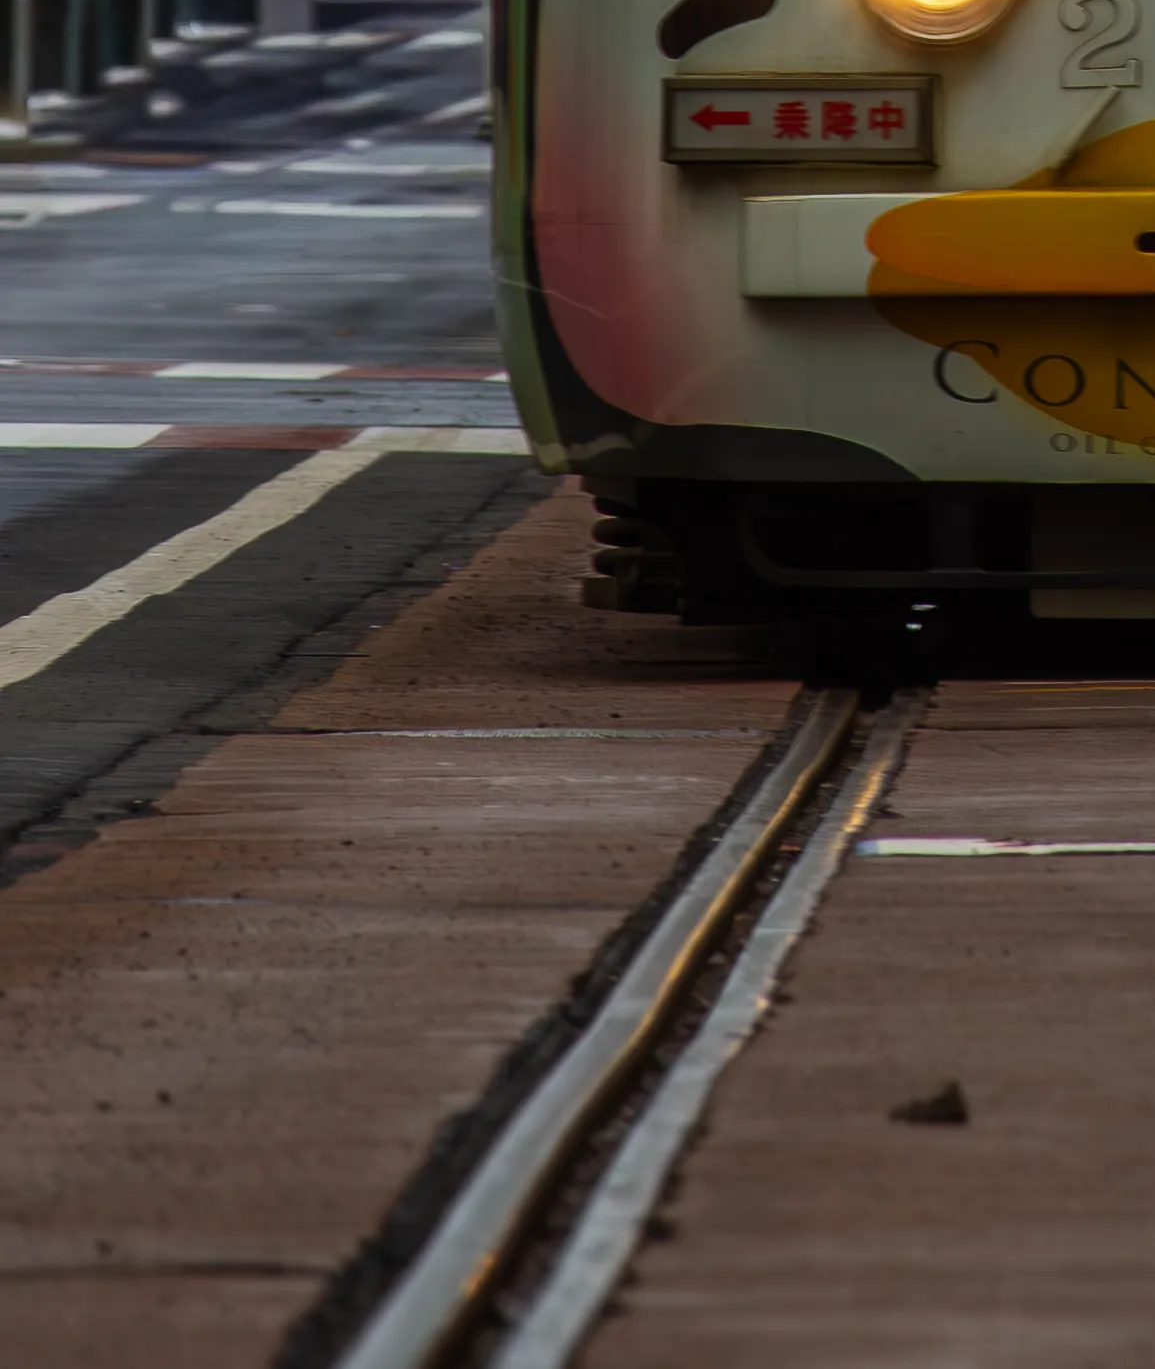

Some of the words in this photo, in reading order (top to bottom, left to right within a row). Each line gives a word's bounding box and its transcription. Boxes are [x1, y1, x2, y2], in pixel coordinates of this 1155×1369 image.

[771, 99, 906, 142] 乗降中
[1048, 431, 1123, 457] OIL
